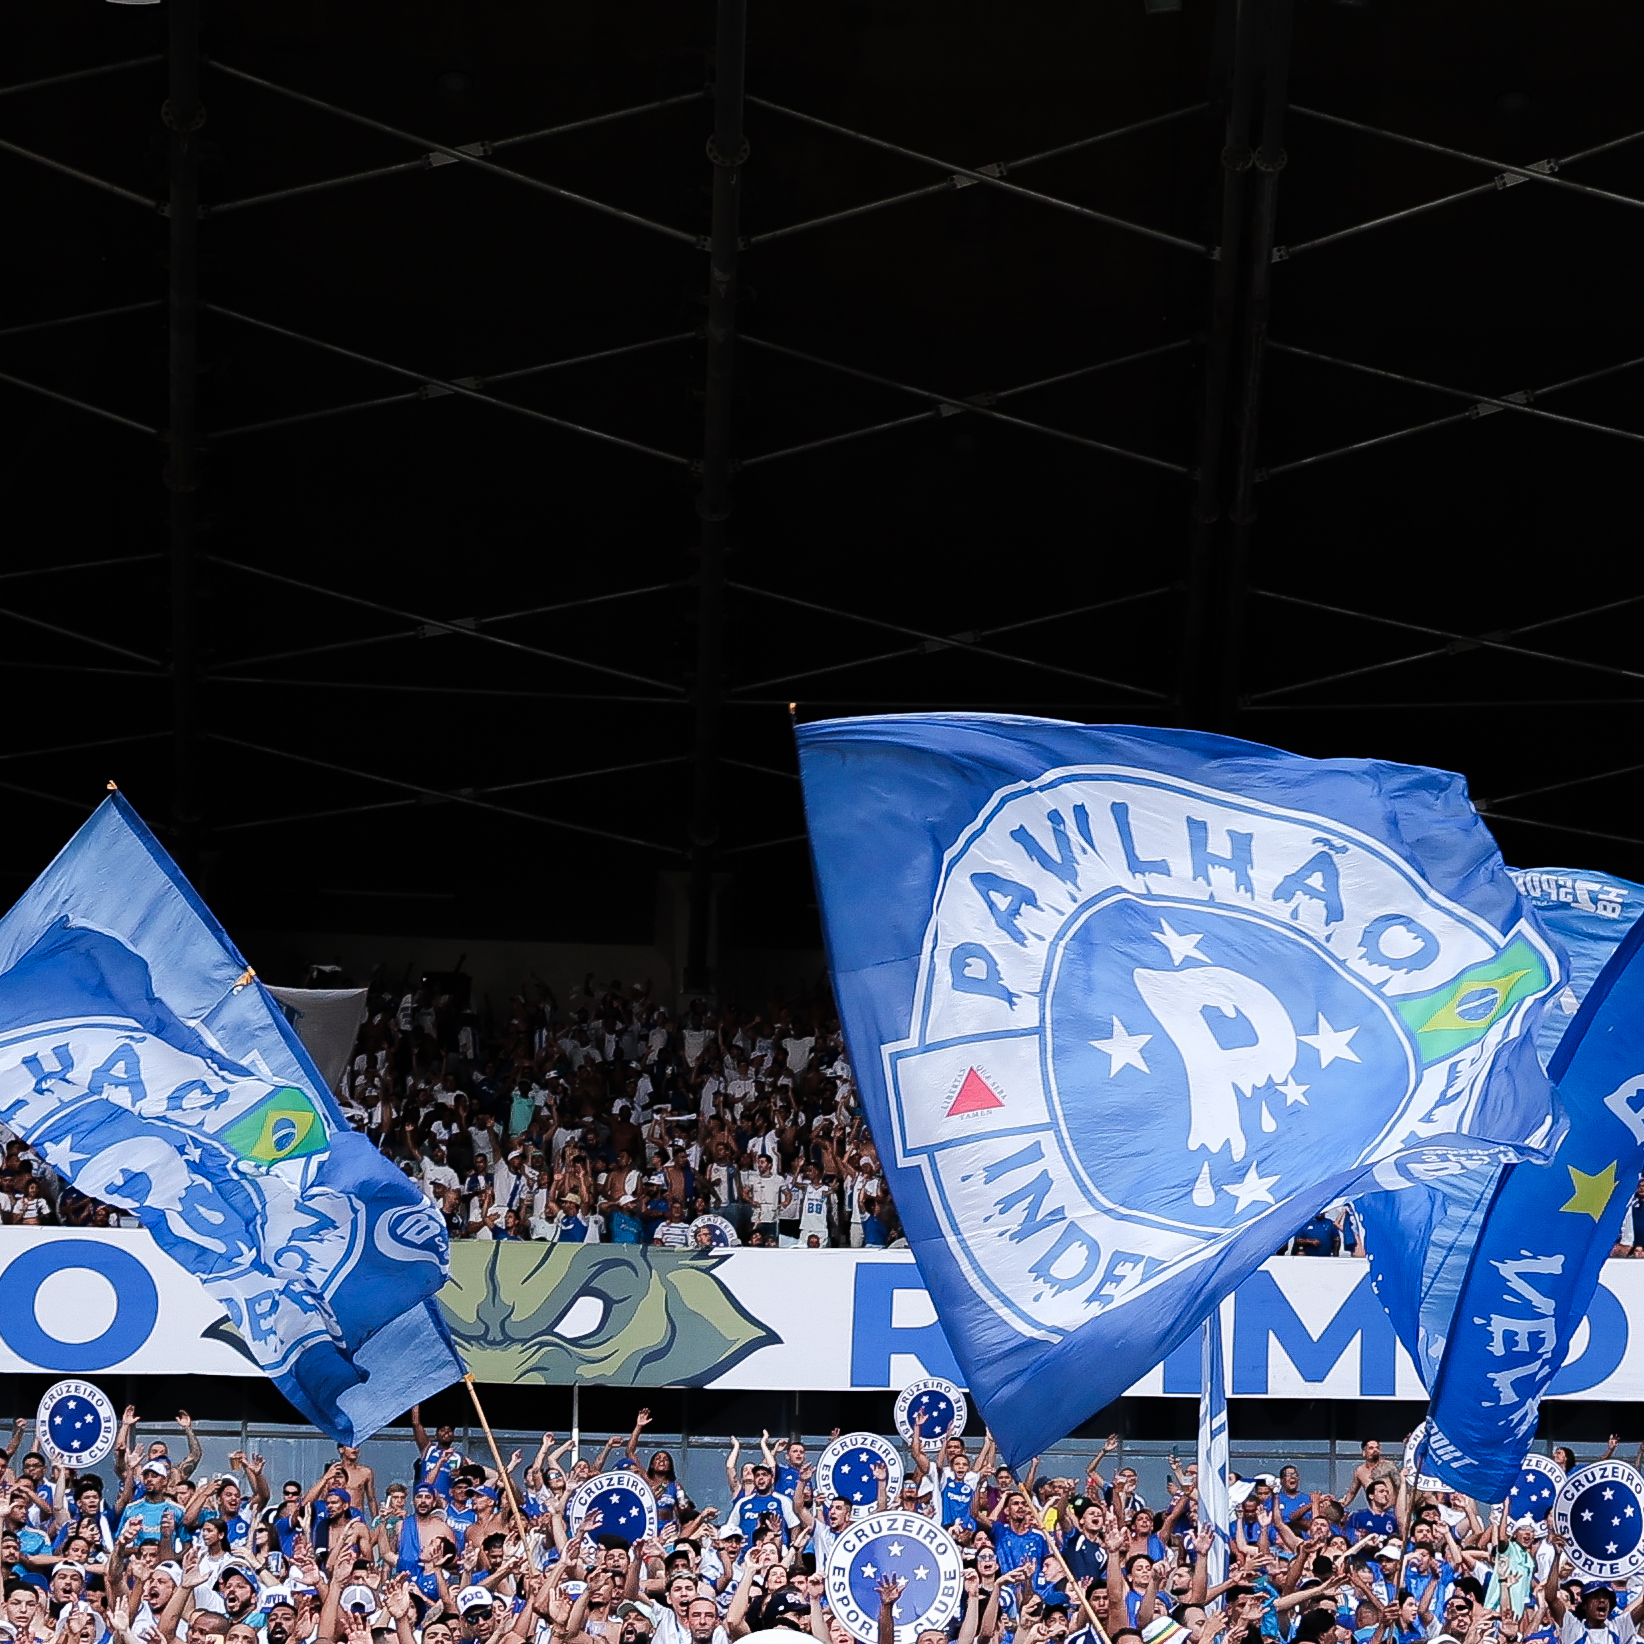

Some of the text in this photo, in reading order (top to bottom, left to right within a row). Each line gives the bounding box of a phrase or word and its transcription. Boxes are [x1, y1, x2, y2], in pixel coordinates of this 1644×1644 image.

[41, 1383, 112, 1414] CRUZEIRO
[899, 1381, 952, 1413] CRUZEIRO
[85, 1415, 113, 1464] CLUBE
[831, 1436, 897, 1467] CRUZEIRO
[578, 1475, 647, 1505] CRUZEIRO
[1563, 1466, 1643, 1502] CRUZEIRO
[843, 1517, 949, 1557] CRUZEIRO
